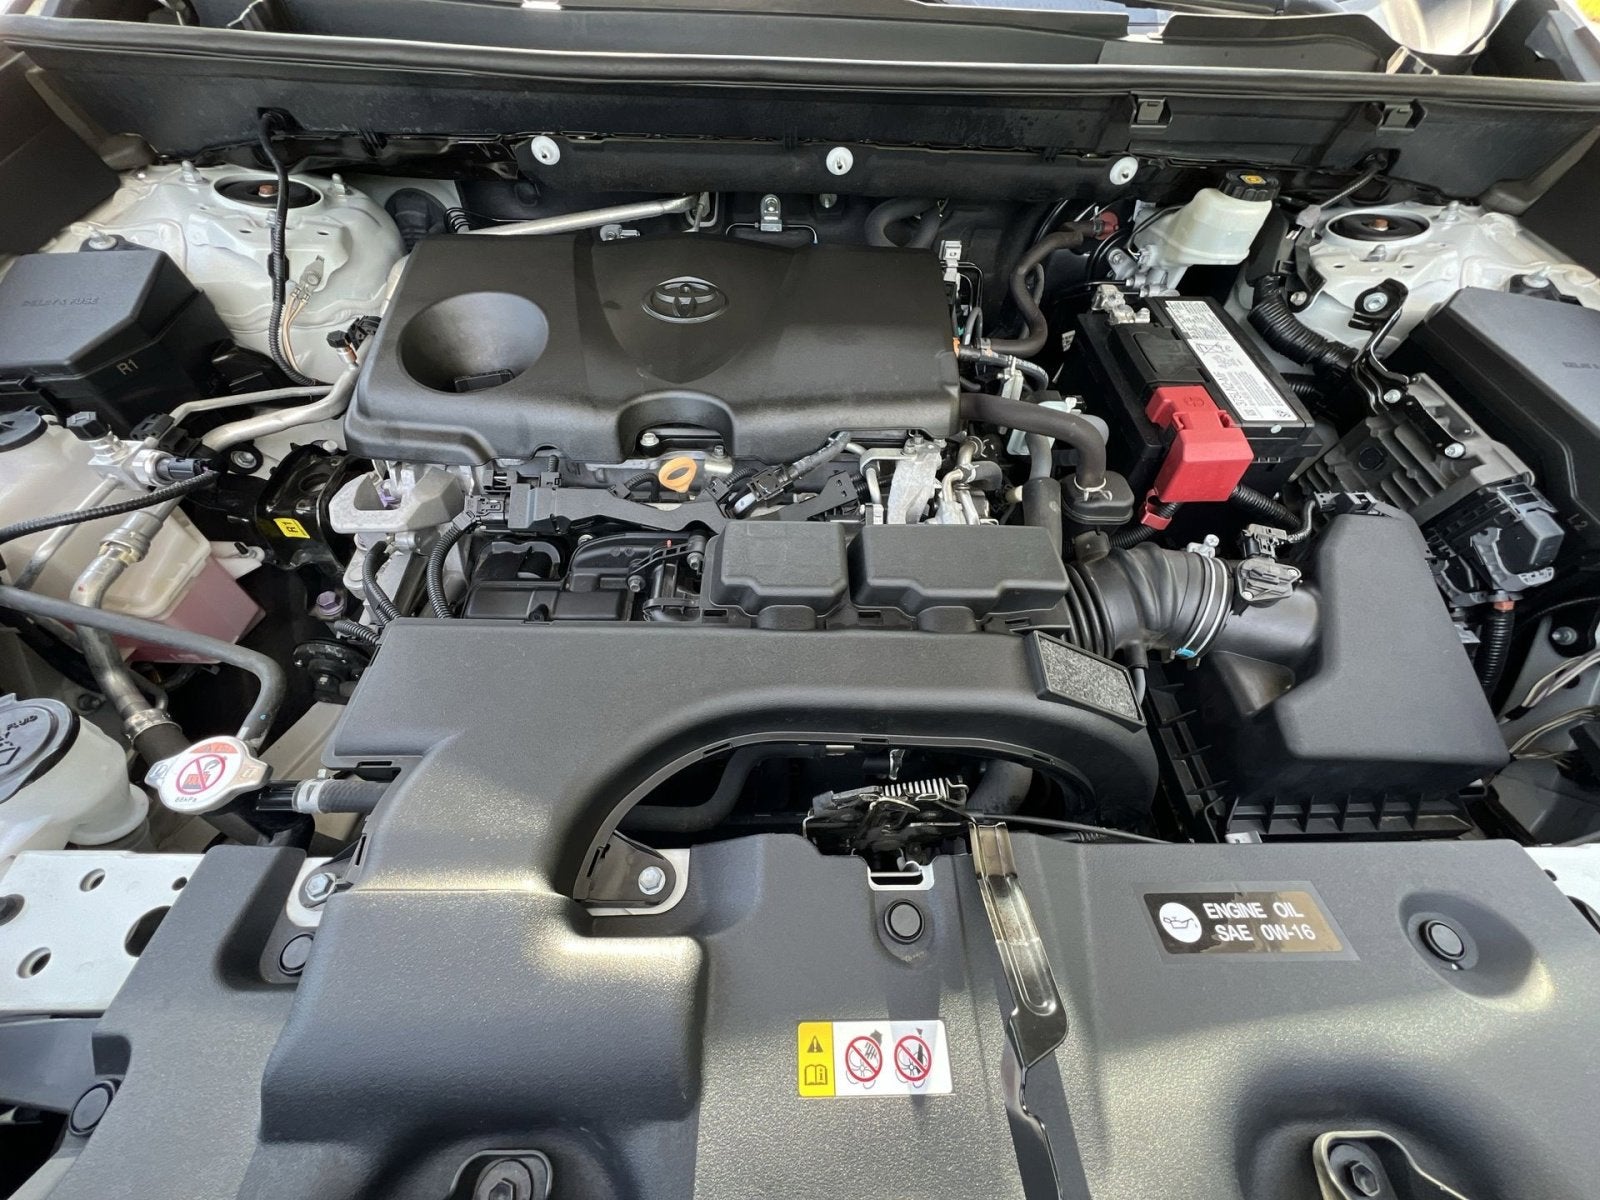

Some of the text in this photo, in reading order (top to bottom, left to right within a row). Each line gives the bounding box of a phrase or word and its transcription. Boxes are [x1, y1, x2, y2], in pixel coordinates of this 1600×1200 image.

[116, 359, 139, 376] R1
[1567, 512, 1588, 531] L2
[7, 715, 38, 731] FLUID
[1202, 901, 1305, 919] ENGINE OIL
[1214, 923, 1317, 942] SAE 0W-16
